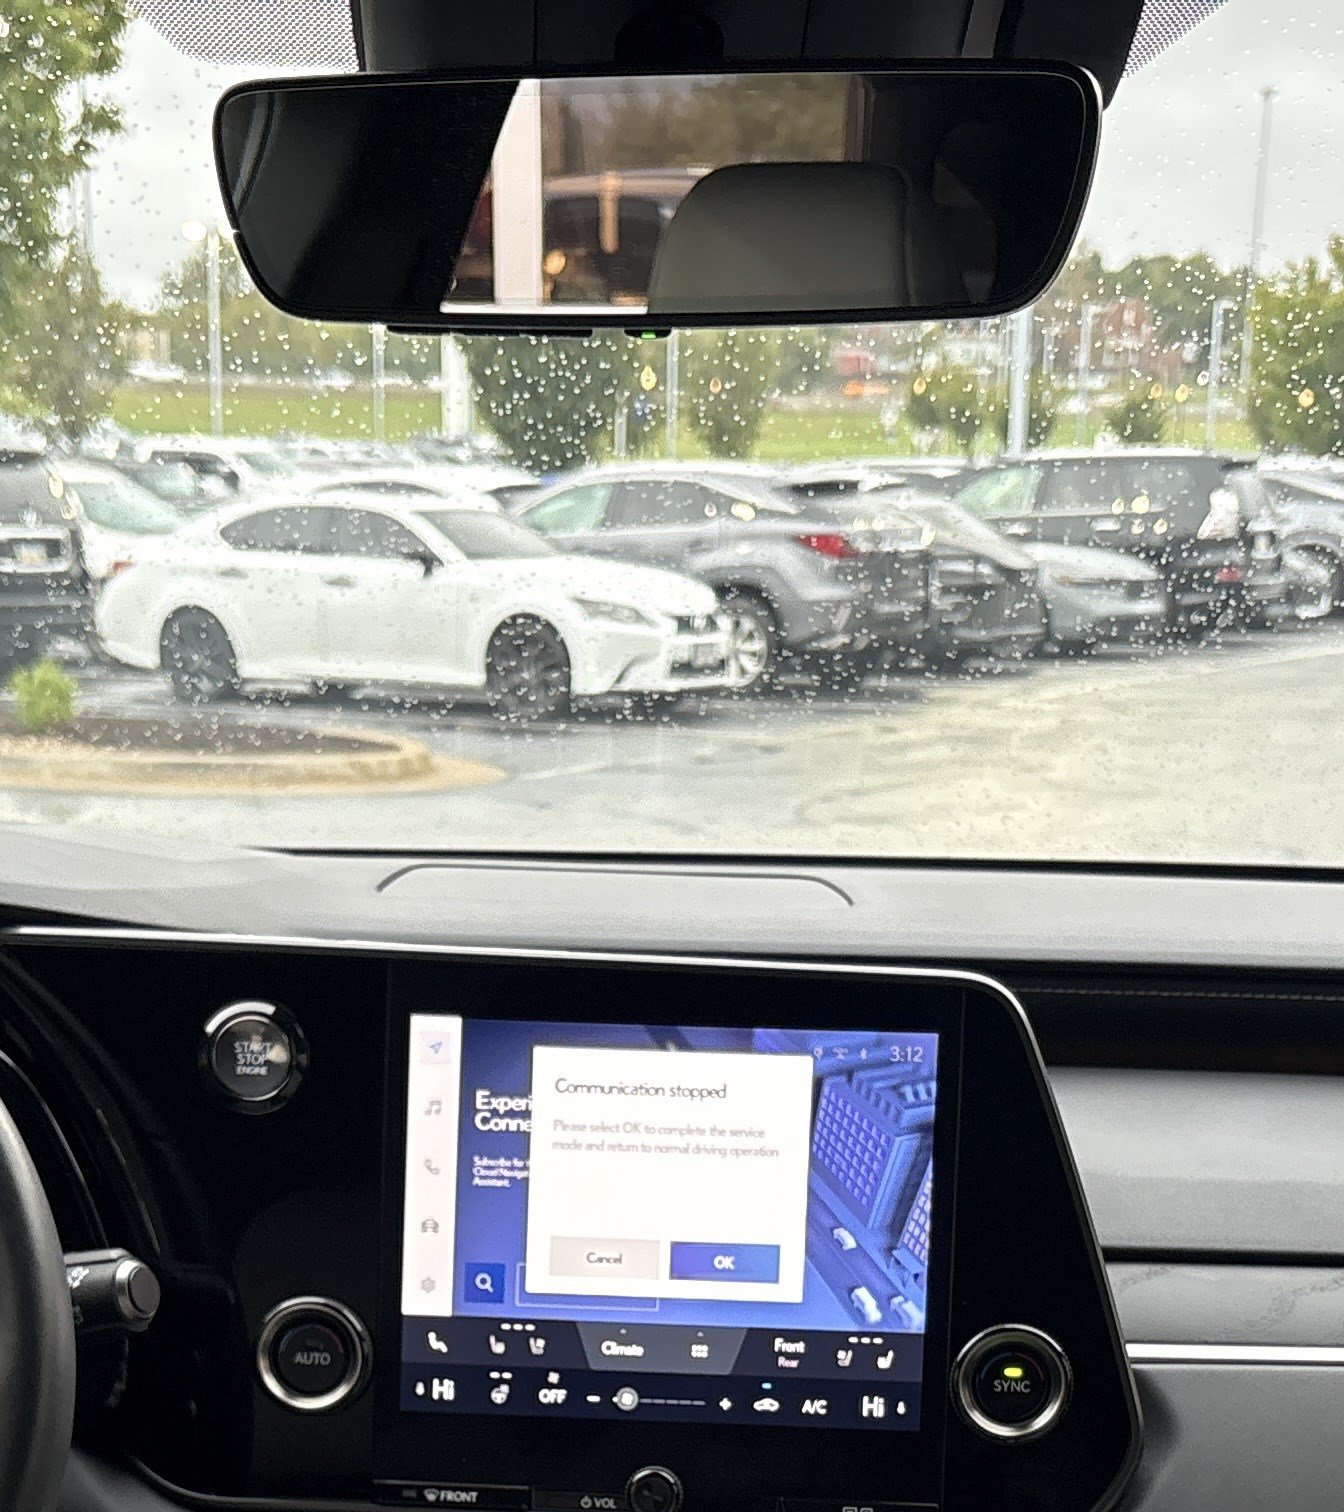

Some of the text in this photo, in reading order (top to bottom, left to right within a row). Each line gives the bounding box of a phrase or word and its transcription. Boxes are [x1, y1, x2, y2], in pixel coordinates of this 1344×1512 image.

[889, 1045, 924, 1063] 3:12
[554, 1078, 727, 1101] Communication stopped
[553, 1119, 766, 1139] Please select OK to complete the service
[551, 1138, 583, 1151] mode
[585, 1139, 604, 1152] and
[607, 1140, 638, 1153] return
[640, 1142, 653, 1154] to
[654, 1142, 690, 1155] normal
[692, 1144, 727, 1158] driving
[586, 1252, 623, 1265] Cancel
[713, 1255, 735, 1270] OK
[601, 1340, 645, 1357] Climate
[774, 1337, 805, 1354] Front
[294, 1351, 331, 1366] AUTO
[777, 1356, 799, 1368] Rear
[432, 1378, 455, 1401] Hi
[993, 1379, 1031, 1393] SYNC
[538, 1388, 568, 1404] OFF
[801, 1399, 828, 1415] A/C
[861, 1395, 886, 1418] Hi
[439, 1489, 478, 1504] FRONT
[593, 1496, 617, 1510] VOL
